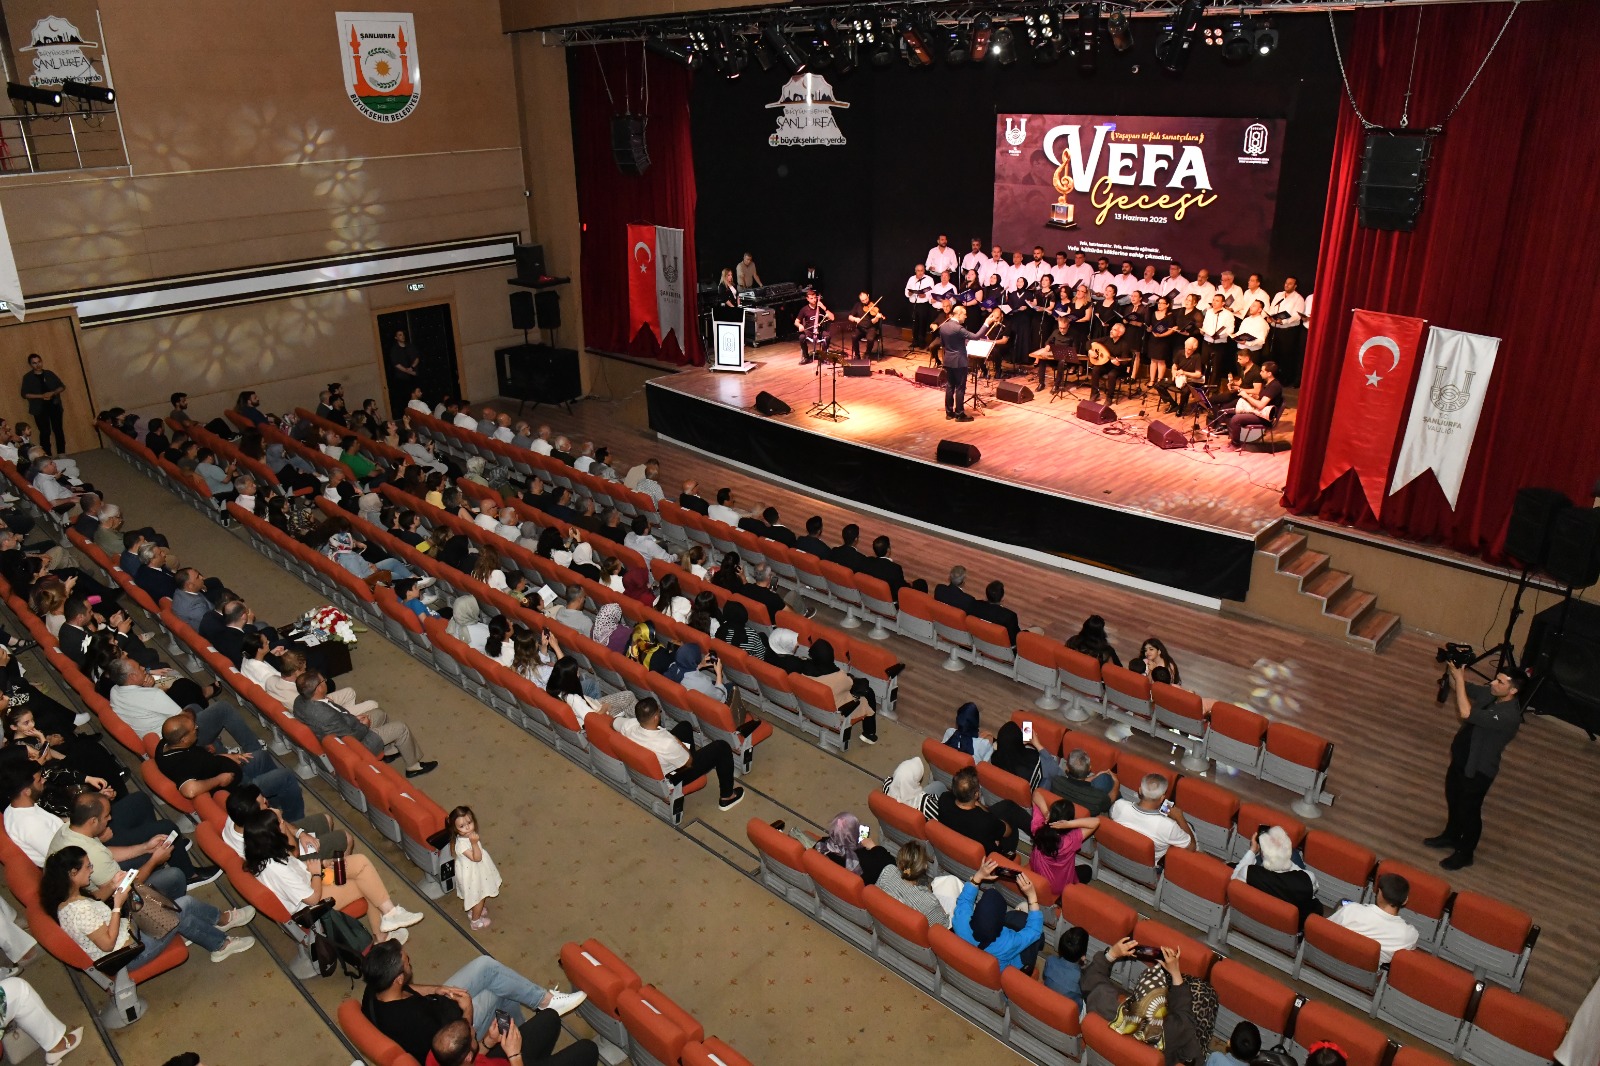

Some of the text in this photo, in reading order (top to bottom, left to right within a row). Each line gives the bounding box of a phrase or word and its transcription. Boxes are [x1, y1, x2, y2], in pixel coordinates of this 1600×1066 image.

[33, 57, 91, 71] ŞANLIURFA
[391, 92, 419, 121] BELEDİYESİ
[1043, 125, 1212, 192] VEFA
[1091, 176, 1217, 225] Gecesi
[1122, 214, 1148, 222] Haziran
[1423, 416, 1462, 429] ŞANLIURFA
